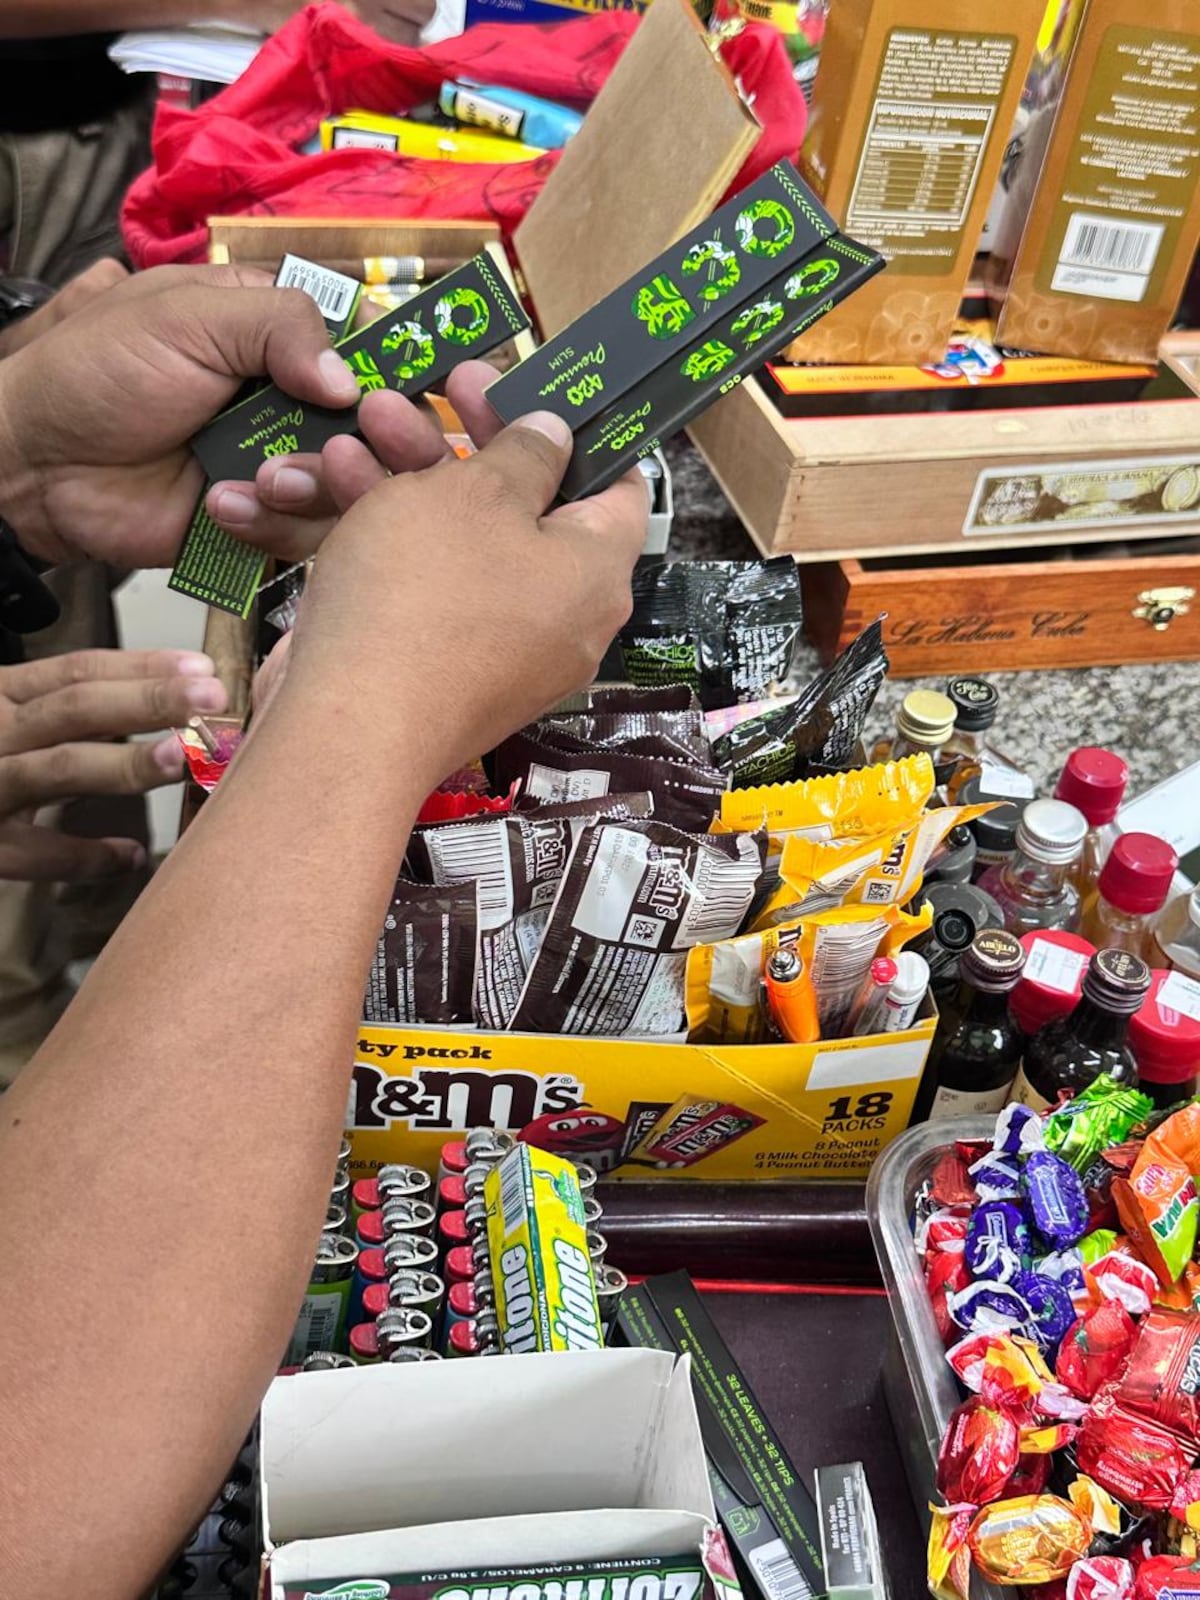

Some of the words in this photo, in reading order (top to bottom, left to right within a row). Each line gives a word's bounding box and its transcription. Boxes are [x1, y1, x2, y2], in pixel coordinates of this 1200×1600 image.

[548, 346, 575, 370] SLIM
[538, 342, 606, 397] Premium
[566, 374, 604, 406] 420
[719, 374, 742, 394] OCB
[238, 408, 305, 450] Premium
[586, 401, 651, 456] Premium
[600, 413, 625, 434] SLIM
[610, 422, 644, 451] 420
[636, 438, 660, 459] SLIM
[885, 618, 924, 647] La
[926, 614, 1017, 645] Habana
[1029, 611, 1092, 639] Cuba
[402, 1042, 493, 1060] pack
[824, 1092, 894, 1121] 18
[820, 1117, 887, 1135] PACKS
[815, 1141, 826, 1150] 8
[828, 1138, 881, 1150] Peanut
[763, 1161, 822, 1169] Peanut
[767, 1152, 800, 1160] Milk
[801, 1150, 879, 1161] Chocolate
[726, 1373, 740, 1392] 32
[735, 1389, 766, 1435] LEAVES
[764, 1441, 780, 1460] 32
[774, 1459, 795, 1488] TIPS
[828, 1503, 838, 1523] Spain
[831, 1530, 841, 1549] Made
[589, 1558, 661, 1569] CONTIENE:
